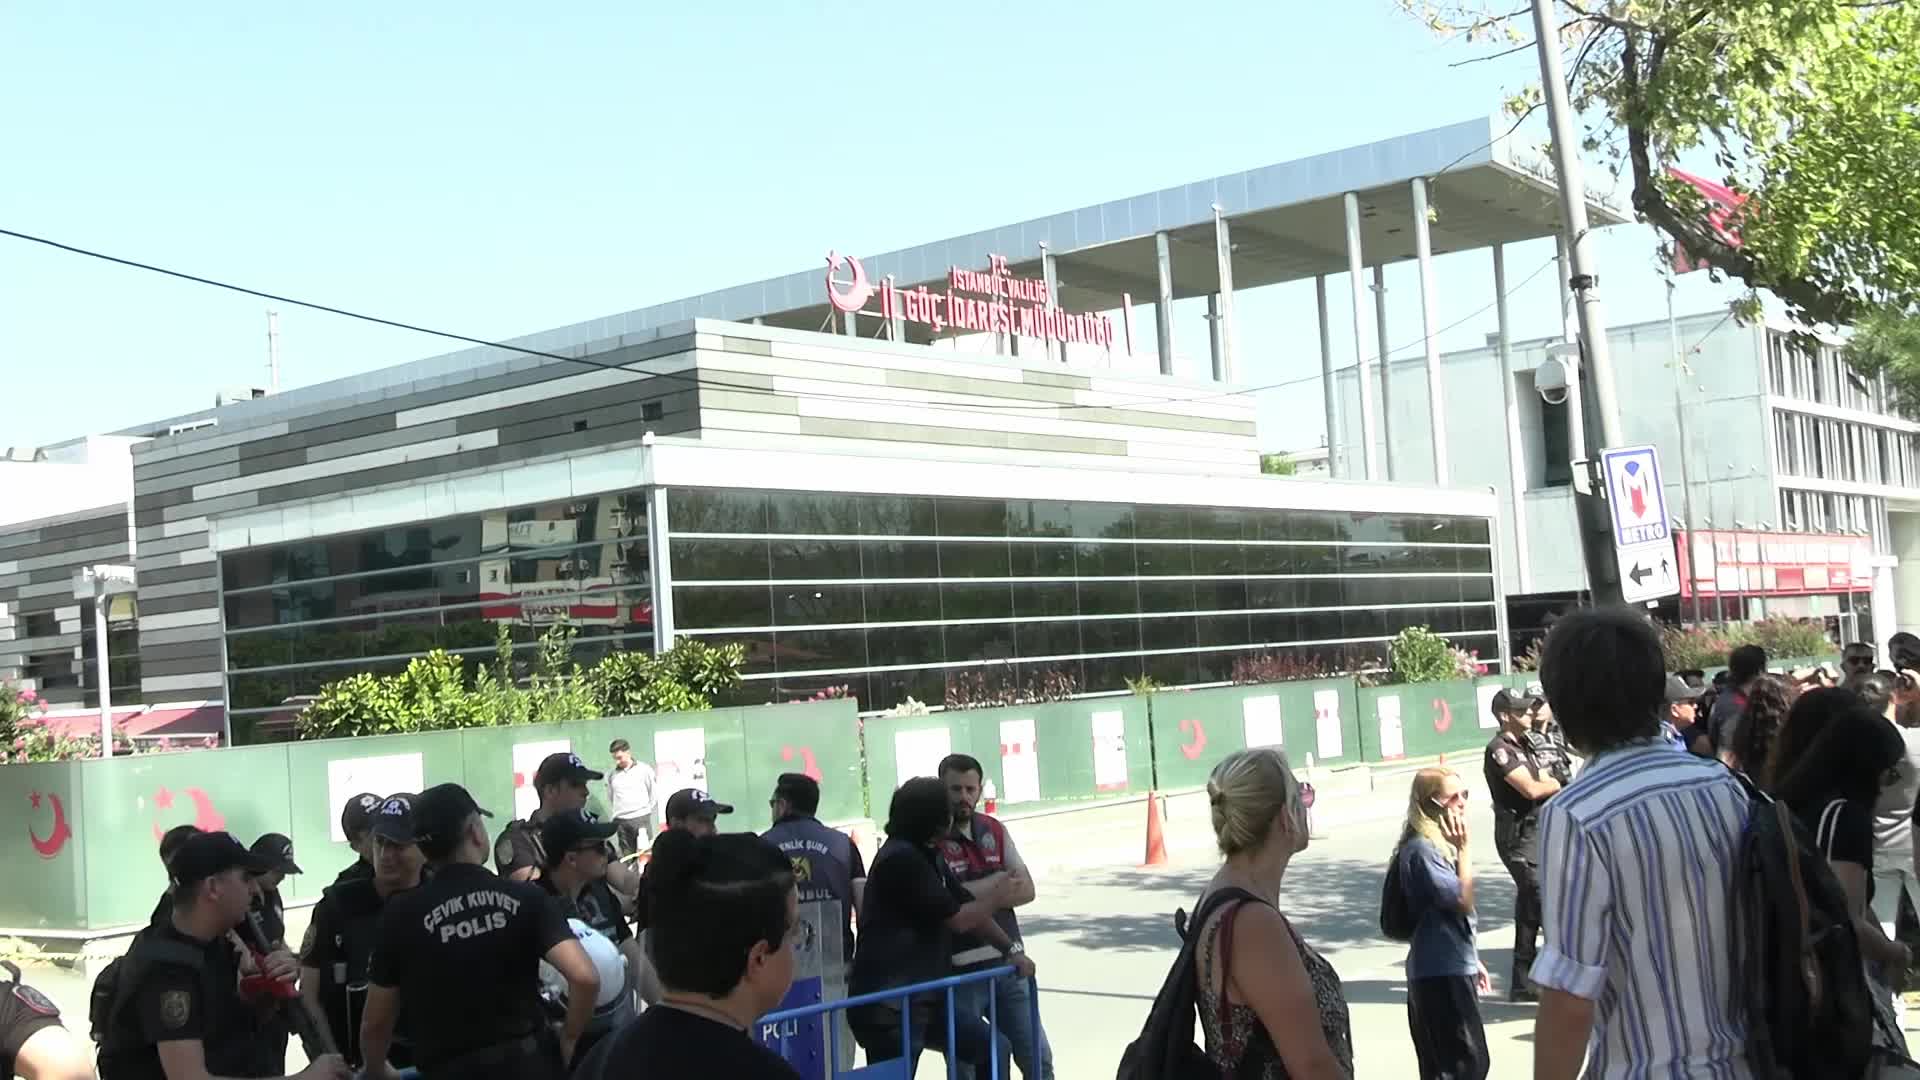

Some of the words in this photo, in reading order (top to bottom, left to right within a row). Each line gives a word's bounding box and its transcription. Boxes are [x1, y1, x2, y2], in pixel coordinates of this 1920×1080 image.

[990, 253, 1012, 276] T.C.
[952, 264, 1008, 298] İSTANBUL
[905, 285, 943, 332] GÖÇ
[946, 289, 1015, 335] İDARESİ
[1623, 522, 1665, 544] METRO
[467, 889, 520, 916] KUVVET
